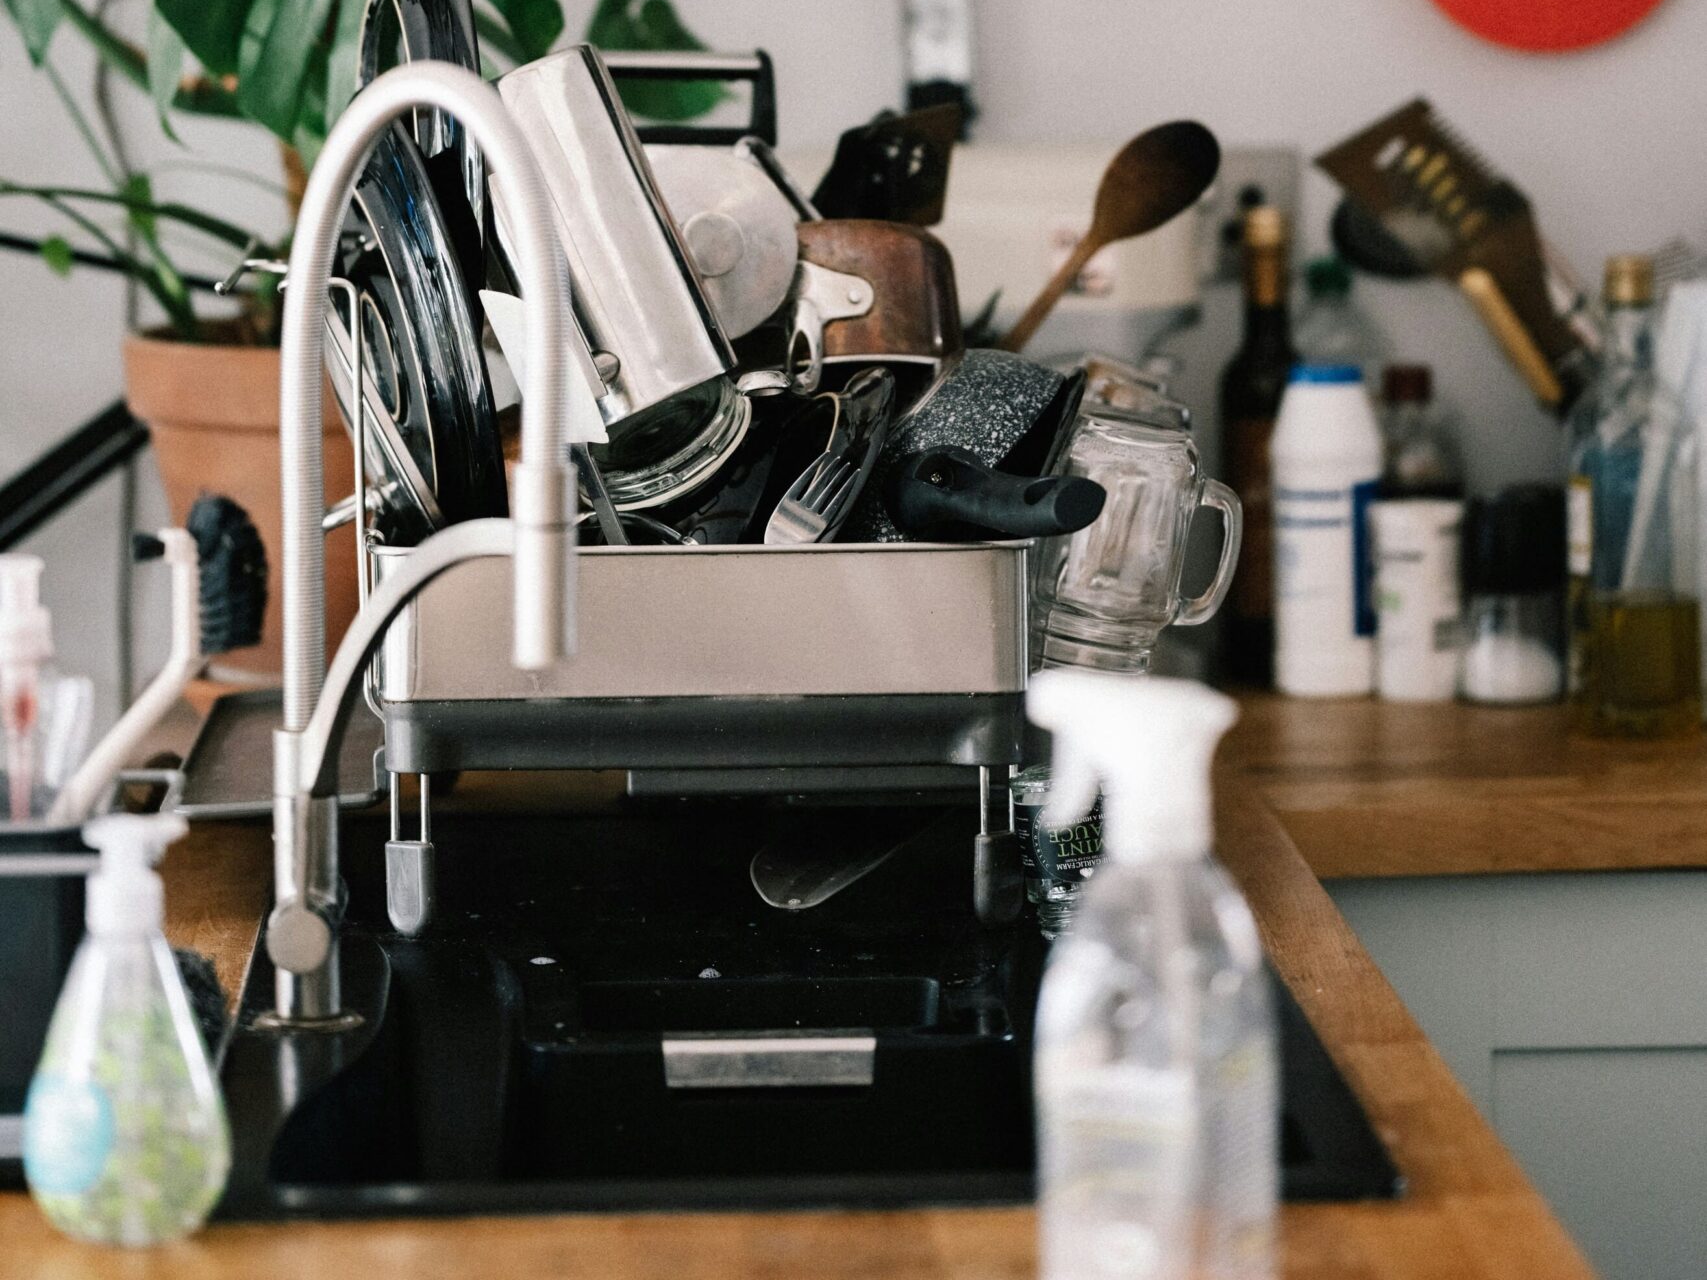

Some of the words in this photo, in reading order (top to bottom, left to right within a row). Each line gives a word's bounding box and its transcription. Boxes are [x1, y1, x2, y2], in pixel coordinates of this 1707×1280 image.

[1047, 822, 1103, 843] AUCE
[1056, 862, 1075, 870] FARM
[1075, 858, 1101, 868] GARLIC
